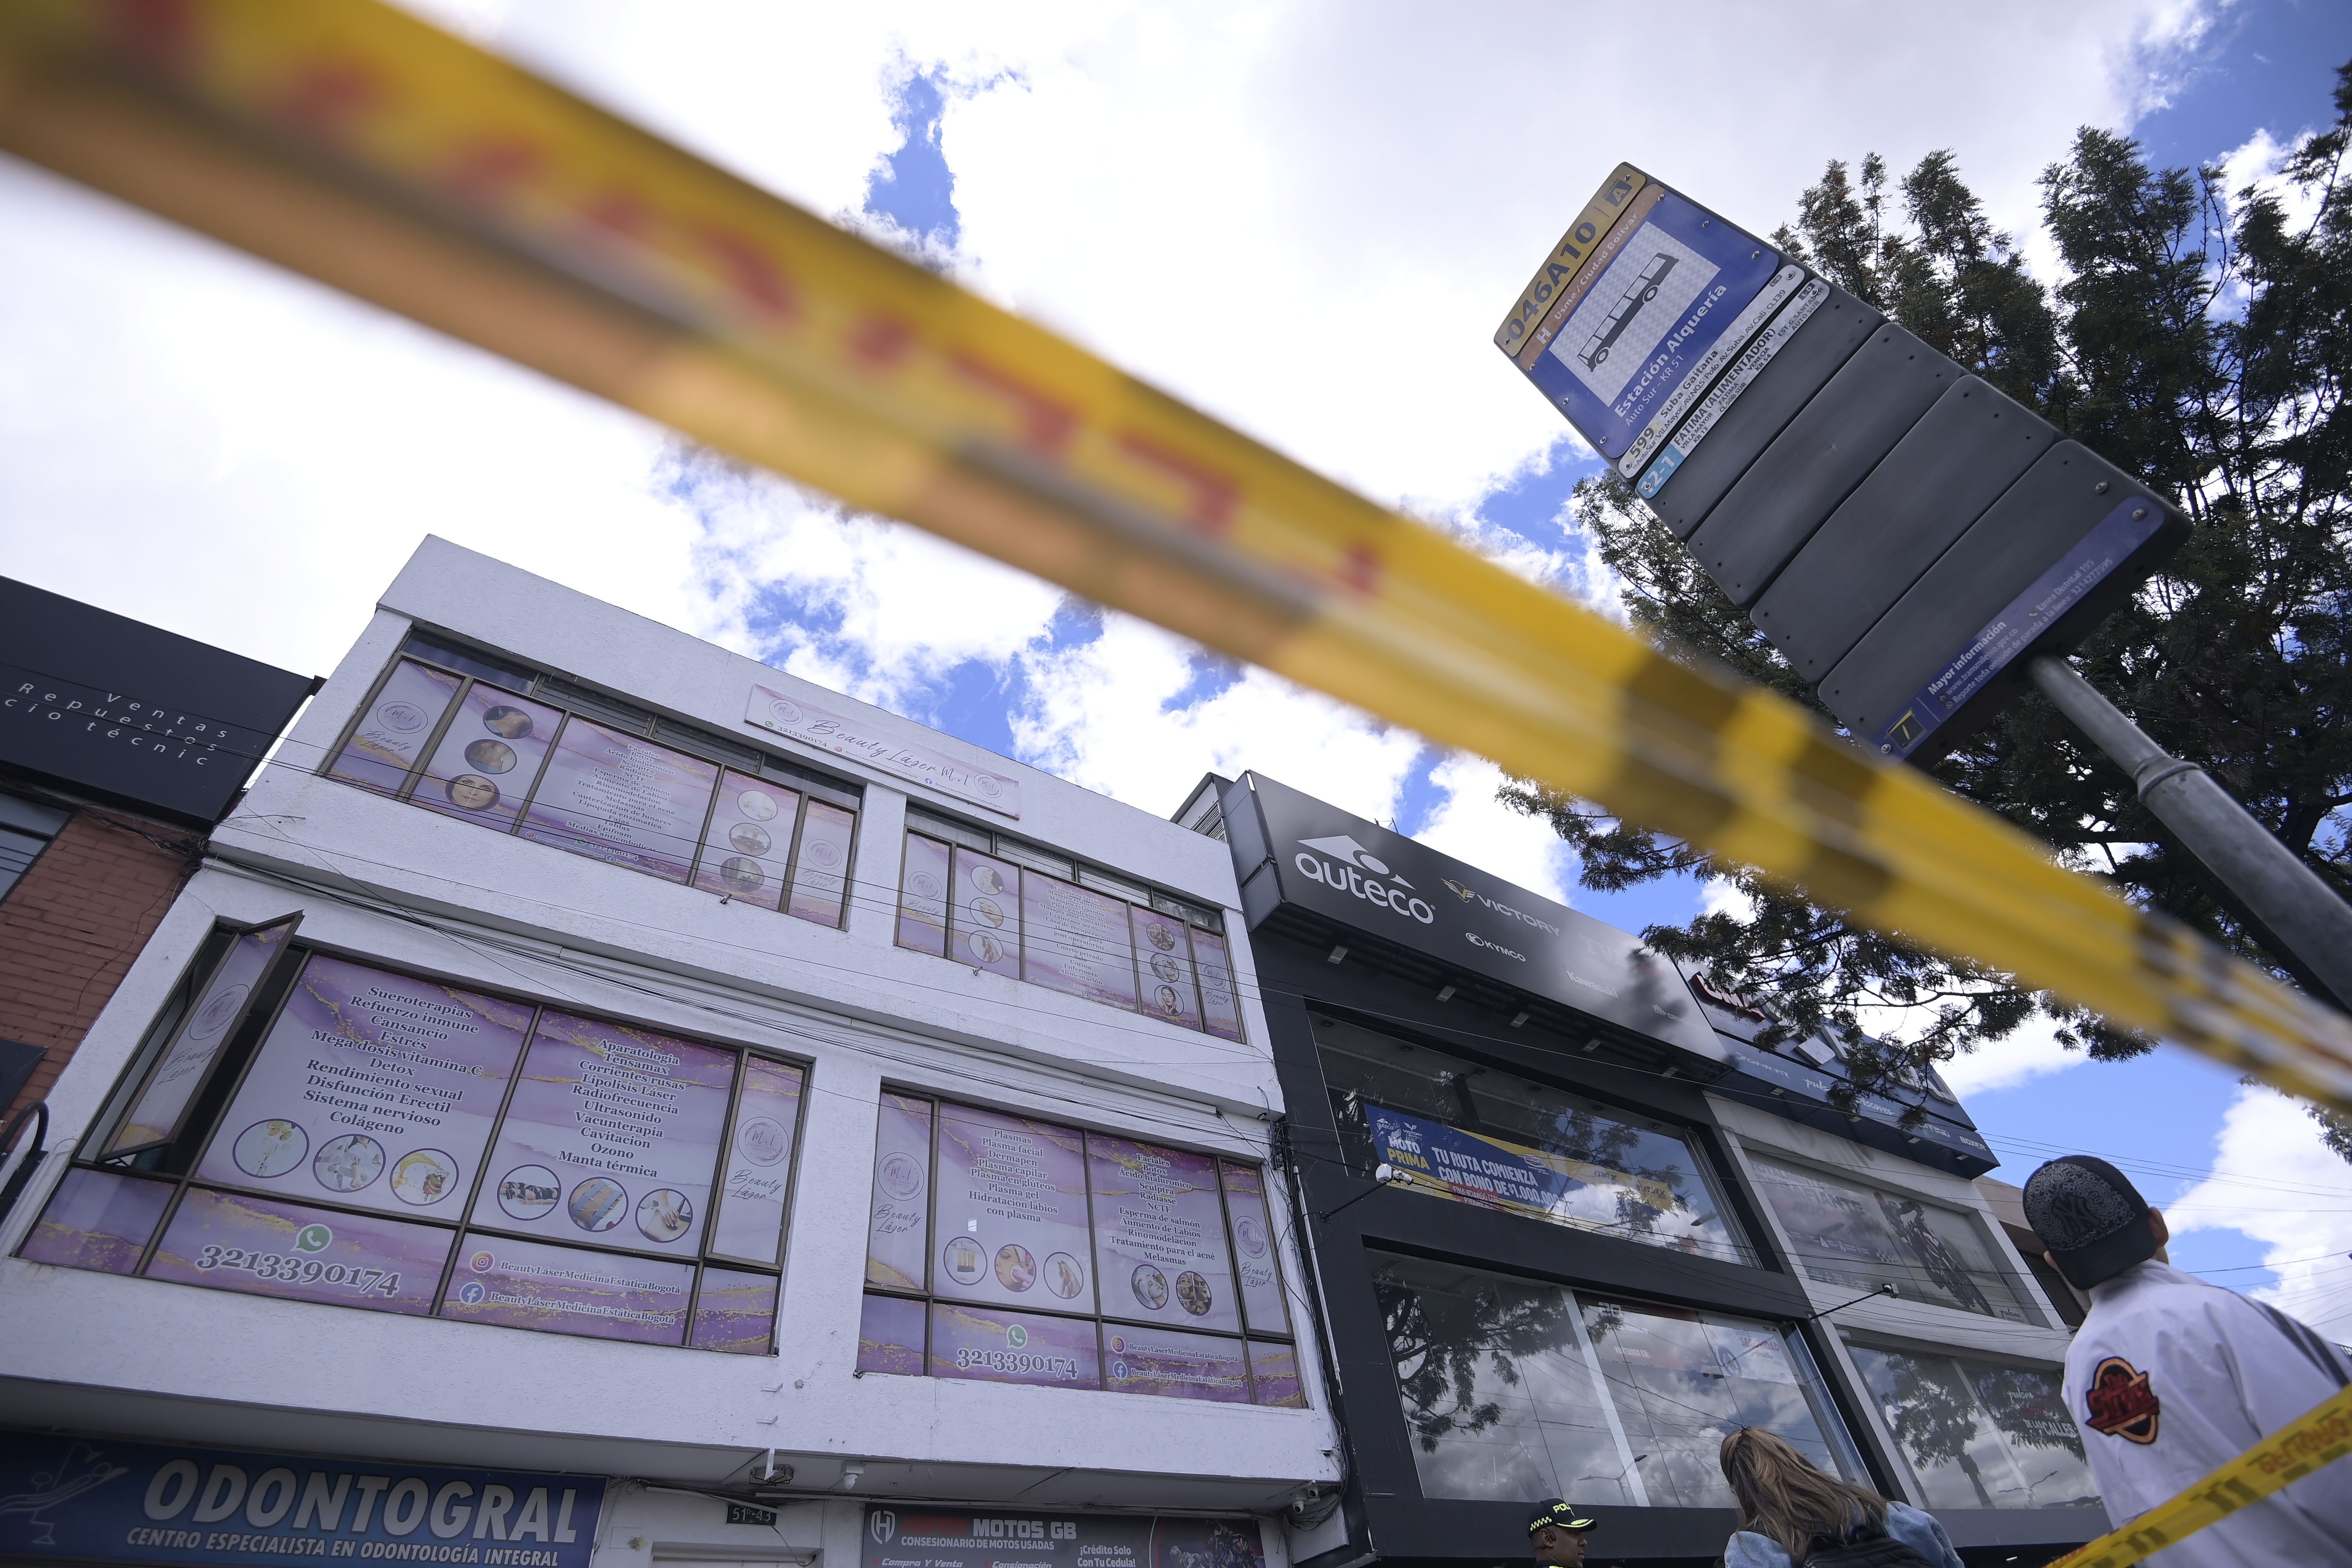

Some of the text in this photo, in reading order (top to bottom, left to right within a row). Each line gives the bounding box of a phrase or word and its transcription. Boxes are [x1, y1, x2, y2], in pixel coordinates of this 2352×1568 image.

[1612, 188, 1628, 203] A
[1554, 212, 1637, 319] Usme Ciudad Bolívar
[1506, 220, 1596, 341] 046A10
[1791, 300, 1820, 331] AUTO SUR
[1536, 327, 1551, 344] H
[1614, 285, 1727, 418] Estación Alquería
[1747, 347, 1770, 370] VENECIA
[1704, 363, 1719, 379] Polo
[1755, 362, 1764, 371] KR
[1625, 354, 1683, 426] Auto Sur KR 51
[1660, 351, 1718, 418] Suba Gaitana
[1673, 328, 1775, 446] FÁTIMA (ALIMENTADOR)
[1718, 382, 1739, 405] FÁTIMA
[1734, 381, 1747, 395] SUR
[1680, 412, 1713, 449] VILLA MAYOR
[1693, 434, 1702, 443] KR
[1629, 427, 1654, 458] 599
[1927, 621, 2007, 694] Mayor información
[19, 683, 218, 751] Repuestos
[107, 693, 227, 738] Ventas
[777, 726, 827, 747] 3213390174
[806, 720, 937, 771] Beauty Láser
[1295, 852, 1434, 924] auteco
[1477, 895, 1560, 936] VICTORY
[1484, 940, 1526, 961] KYMCO
[1566, 971, 1619, 999] Kawasaki
[368, 987, 471, 1018] Sueroterapias
[349, 996, 478, 1033] Refuerzo inmune
[371, 1015, 447, 1040] Cansancio
[379, 1031, 427, 1049] Estrés
[310, 1029, 482, 1075] Mega dosis vitamina C
[596, 1040, 678, 1064] Aparatologia
[604, 1052, 668, 1074] Tensamax
[368, 1057, 415, 1075] Detox
[580, 1060, 684, 1090] Corrientes rusas
[305, 1059, 463, 1100] Rendimiento sexual
[582, 1073, 676, 1100] Lipolisis Láser
[306, 1074, 451, 1113] Disfunción Erectil
[572, 1084, 678, 1114] Radiofrecuencia
[303, 1089, 440, 1126] Sistema nervioso
[584, 1100, 661, 1123] Ultrasonido
[330, 1111, 404, 1134] Colágeno
[575, 1111, 662, 1137] Vacunterapia
[581, 1127, 650, 1148] Cavitacion
[982, 1138, 1043, 1157] Plasma facial
[994, 1130, 1031, 1144] Plasmas
[1388, 1135, 1421, 1154] MOTO
[1960, 1135, 1986, 1151] BOXER
[591, 1143, 634, 1158] Ozono
[988, 1149, 1037, 1166] Dermapen
[1137, 1154, 1170, 1166] Faciales
[1386, 1147, 1430, 1170] PRIMA
[558, 1150, 657, 1177] Manta térmica
[978, 1158, 1047, 1178] Plasma capilar
[1143, 1164, 1166, 1175] Botox
[1431, 1146, 1449, 1164] TU
[1451, 1152, 1481, 1172] RUTA
[1485, 1160, 1538, 1187] COMIENZA
[971, 1168, 1005, 1182] Plasma
[1021, 1178, 1055, 1191] glúteos
[1119, 1167, 1191, 1189] Ácido hialuronico
[1139, 1182, 1174, 1195] Sculptra
[1438, 1165, 1462, 1183] CON
[1462, 1171, 1493, 1192] BONO
[1494, 1179, 1509, 1196] DE
[969, 1190, 1057, 1214] Hidratacion labios
[988, 1183, 1038, 1199] Plasma gel
[1140, 1191, 1176, 1204] Radiasse
[986, 1207, 1041, 1222] con plasma
[1147, 1202, 1171, 1212] NCTF
[1128, 1228, 1197, 1247] Rinomodelacion
[1143, 1251, 1186, 1265] Melasmas
[198, 1246, 399, 1296] 3213390174
[958, 1349, 1077, 1378] 3213390174
[144, 1459, 577, 1543] ODONTOGRAL
[973, 1519, 1076, 1539] MOTOS GB
[126, 1527, 558, 1567] CENTRO ESPECIALISTA EN ODONTOLOGÍA INTEGRAL
[901, 1536, 1054, 1550] CONSESIONARIO DE MOTOS USADAS
[1080, 1545, 1131, 1556] ¡Crédito Solo
[882, 1557, 921, 1568] Compra
[935, 1560, 963, 1568] Venta
[1078, 1557, 1136, 1568] Con Tu Cedula!
